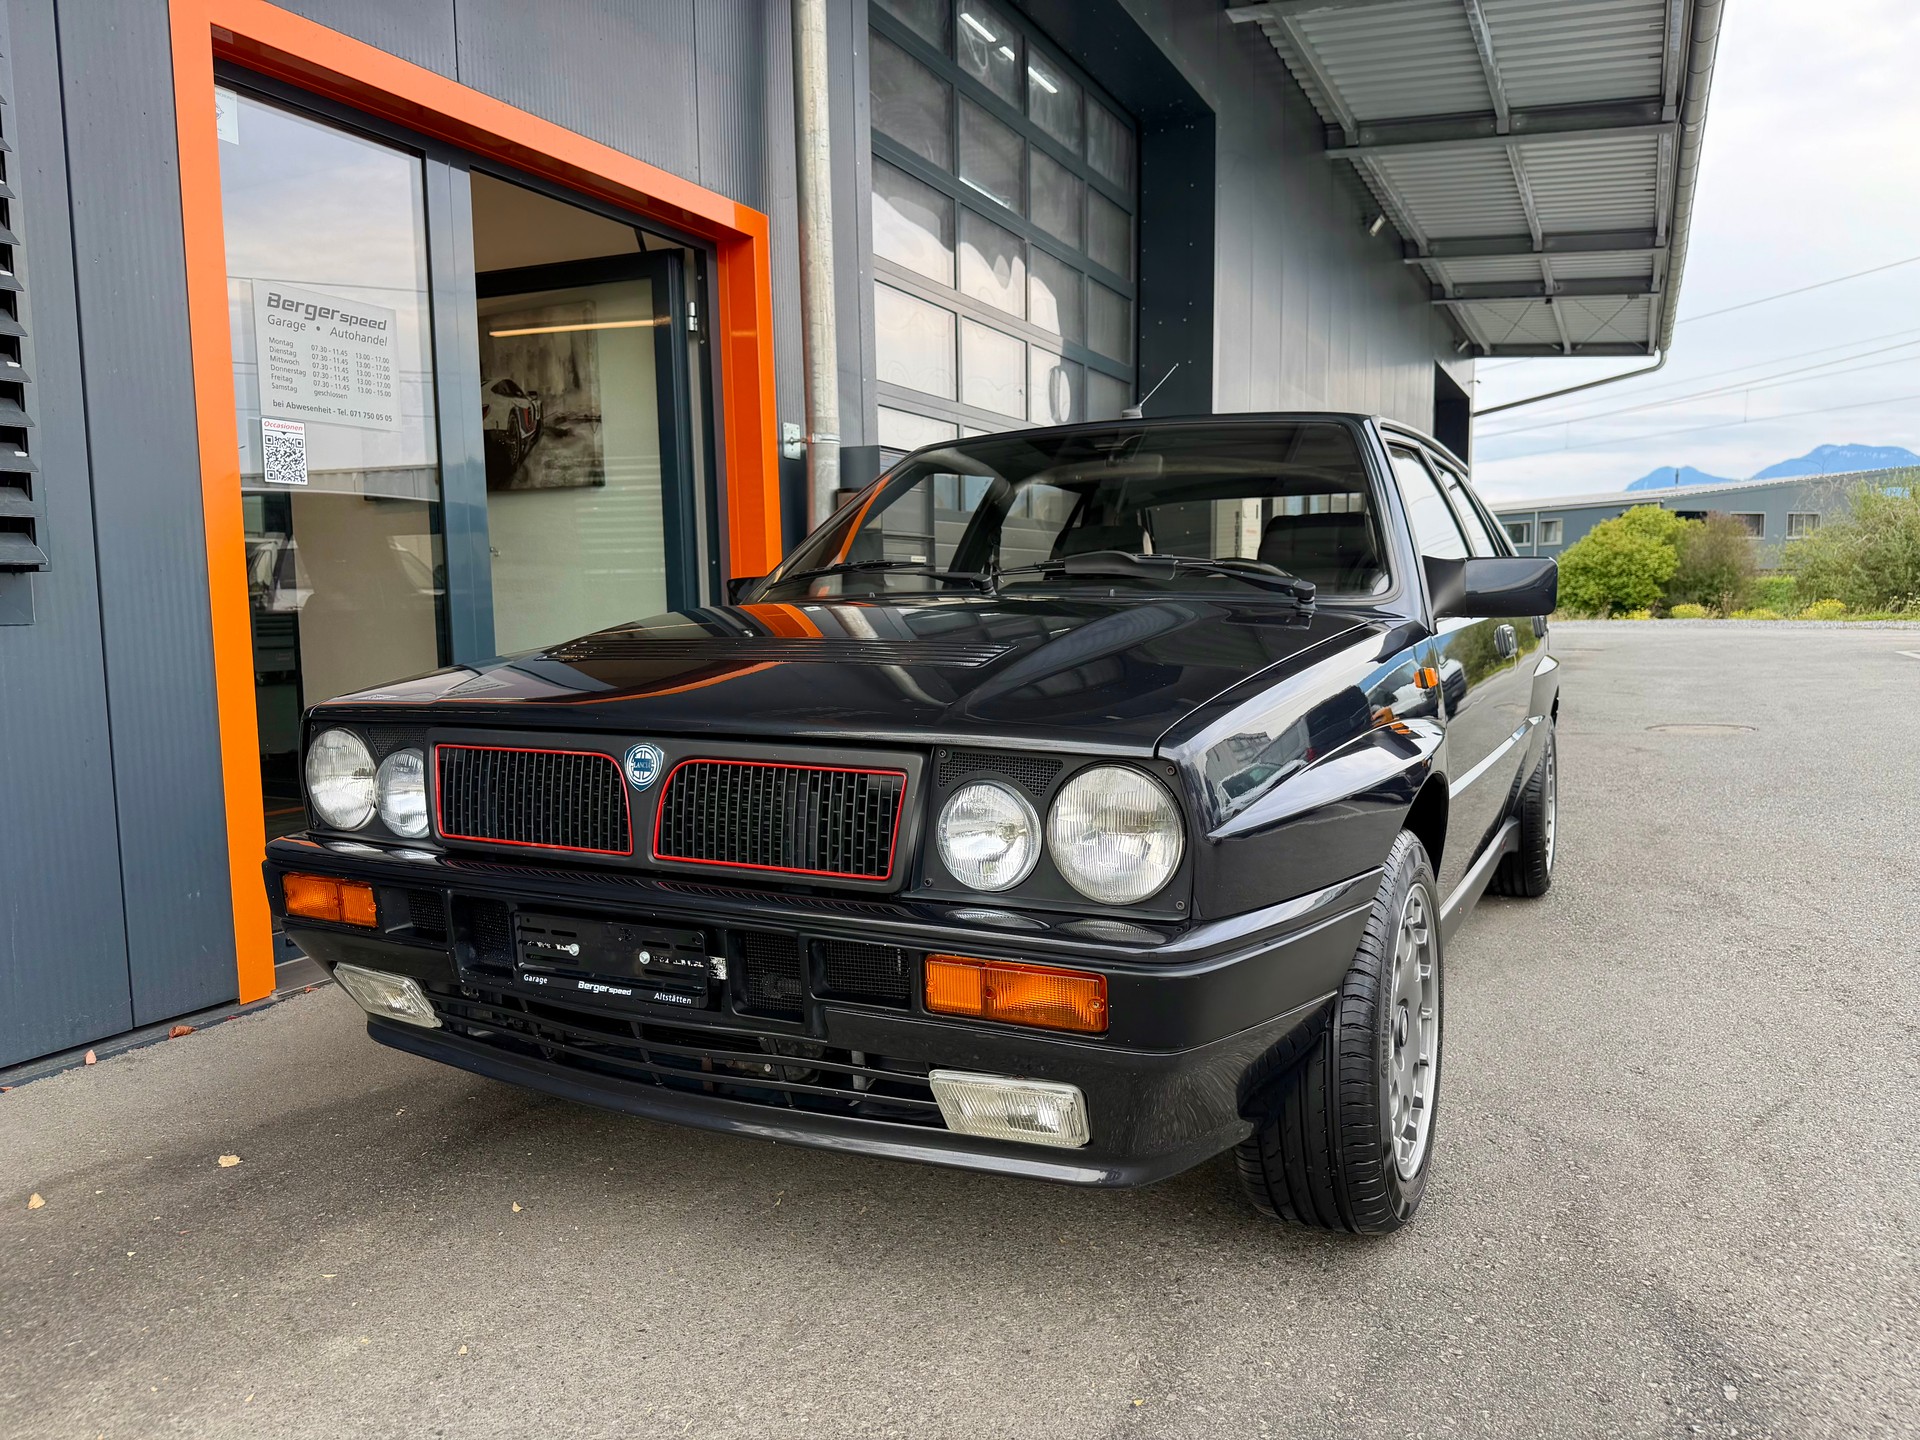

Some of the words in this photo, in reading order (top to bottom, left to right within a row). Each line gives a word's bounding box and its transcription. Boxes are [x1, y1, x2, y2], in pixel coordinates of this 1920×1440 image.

[267, 292, 387, 330] Bergerspeed
[267, 314, 306, 332] Garage
[330, 327, 388, 346] Autohandel
[269, 337, 294, 348] Montag
[311, 345, 327, 354] 07.30
[333, 348, 348, 356] 11.45
[270, 346, 296, 358] Dienstag
[312, 354, 328, 362] 07.30
[333, 357, 348, 365] 11.45
[376, 365, 390, 373] 17.00
[270, 355, 300, 365] Mittwoch
[270, 364, 306, 377] Donnerstag
[313, 371, 329, 379] 07.30
[271, 373, 293, 384] Freitag
[313, 380, 329, 388] 07.30
[272, 382, 298, 393] Samstag
[314, 390, 348, 399] geschlossen
[273, 400, 284, 408] bei
[286, 402, 331, 414] Abwesenheit
[264, 420, 303, 431] Occasionen
[523, 974, 548, 984] Garage
[578, 980, 632, 996] Bergerspeed
[654, 992, 692, 1004] Altstätten
